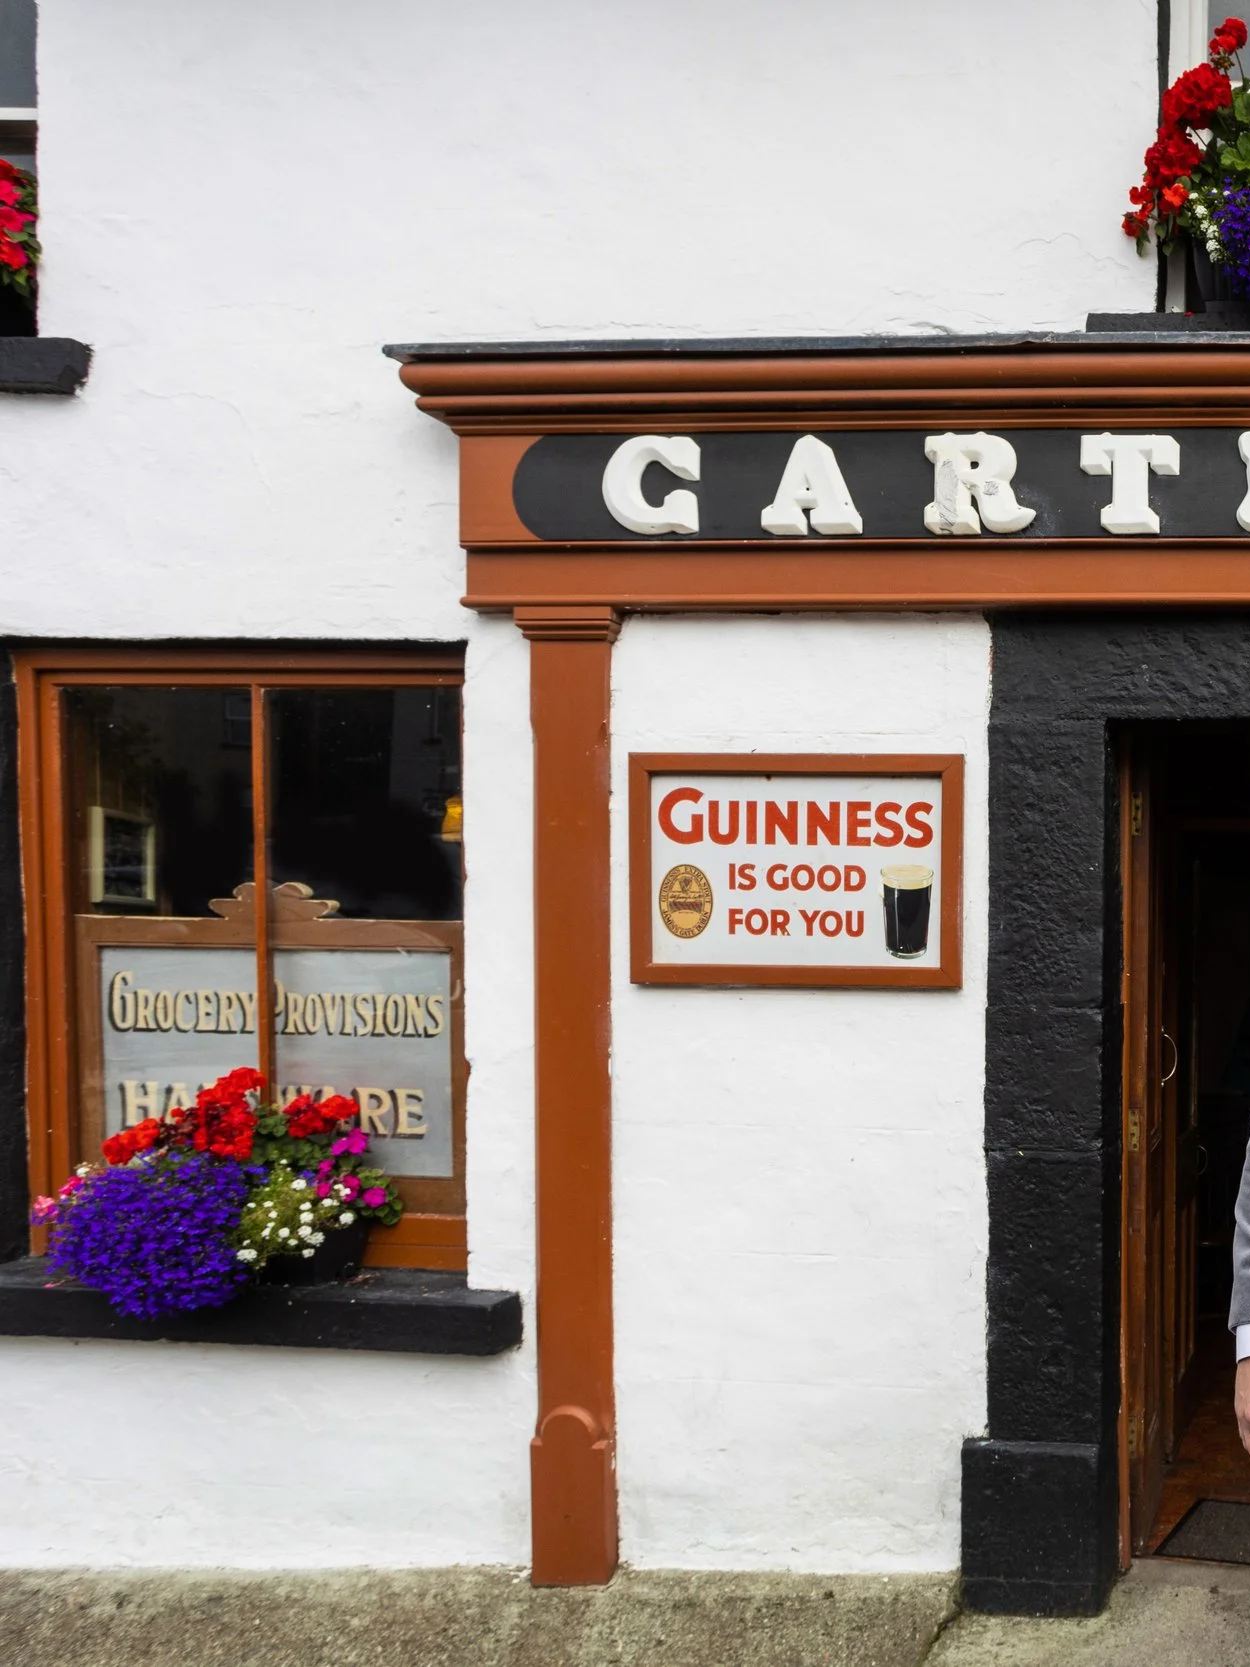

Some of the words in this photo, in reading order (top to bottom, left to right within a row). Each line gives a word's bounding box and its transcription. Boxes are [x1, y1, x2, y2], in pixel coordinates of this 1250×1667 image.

[658, 786, 935, 848] GUINNESS
[728, 863, 757, 891] IS
[766, 864, 867, 892] GOOD
[728, 908, 791, 936] FOR
[798, 909, 864, 937] YOU
[109, 971, 257, 1035] GROCERY
